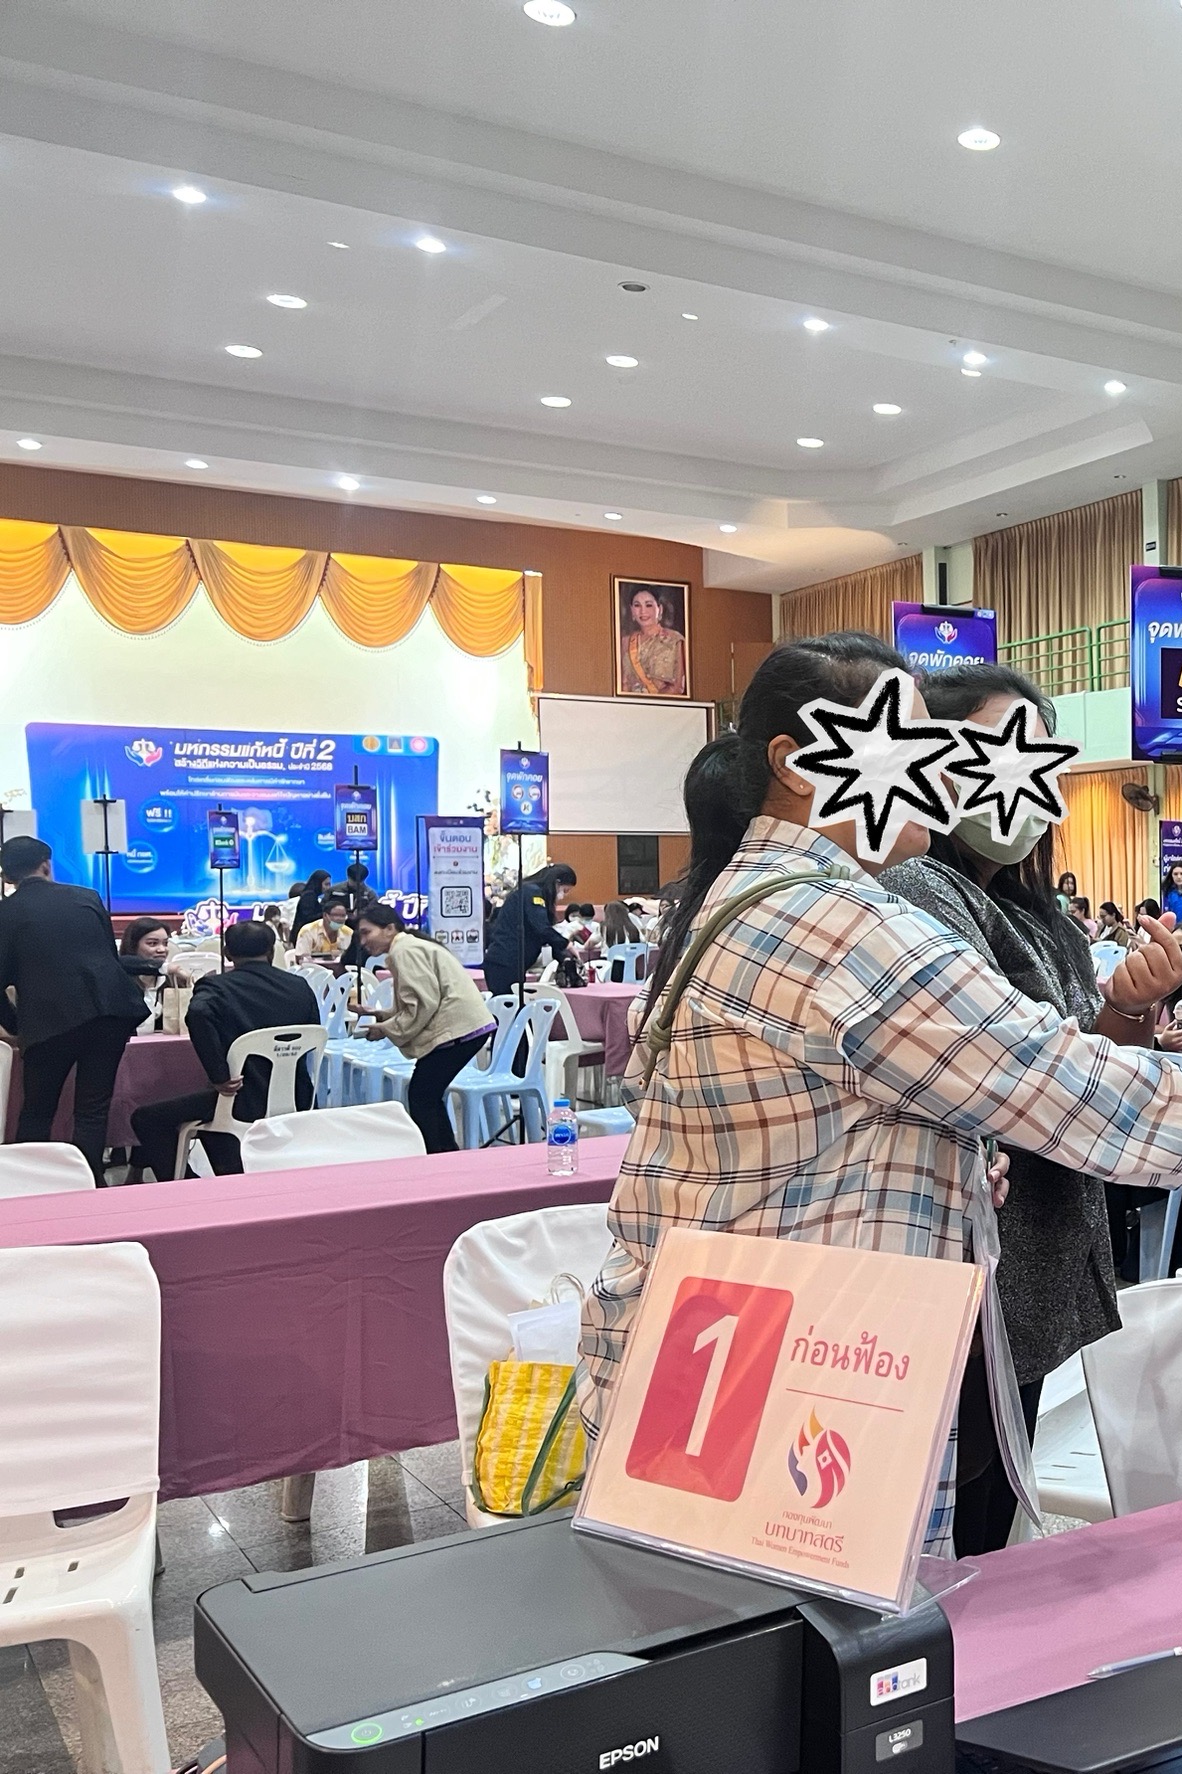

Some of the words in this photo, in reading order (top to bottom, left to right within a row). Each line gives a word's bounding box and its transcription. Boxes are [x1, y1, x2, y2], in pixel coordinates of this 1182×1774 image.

[173, 738, 288, 759] มหกรรมแก้หนี้
[290, 738, 318, 760] ปีที่
[317, 739, 336, 761] 2
[310, 762, 333, 772] 2568
[506, 771, 543, 783] จุดพักคอย
[347, 825, 367, 834] BAM
[440, 829, 472, 843] ขั้นตอน
[433, 843, 478, 854] เข้าร่วมงาน
[790, 1325, 910, 1380] ก่อนฟ้อง
[685, 1314, 739, 1457] 1
[782, 1511, 832, 1529] กองทุนพัฒนา
[765, 1521, 845, 1553] บทบาทสตรี
[751, 1536, 764, 1547] Thai
[765, 1540, 787, 1553] Women
[788, 1546, 831, 1563] Empowerment
[888, 1728, 911, 1743] L3250
[599, 1735, 659, 1770] EPSON
